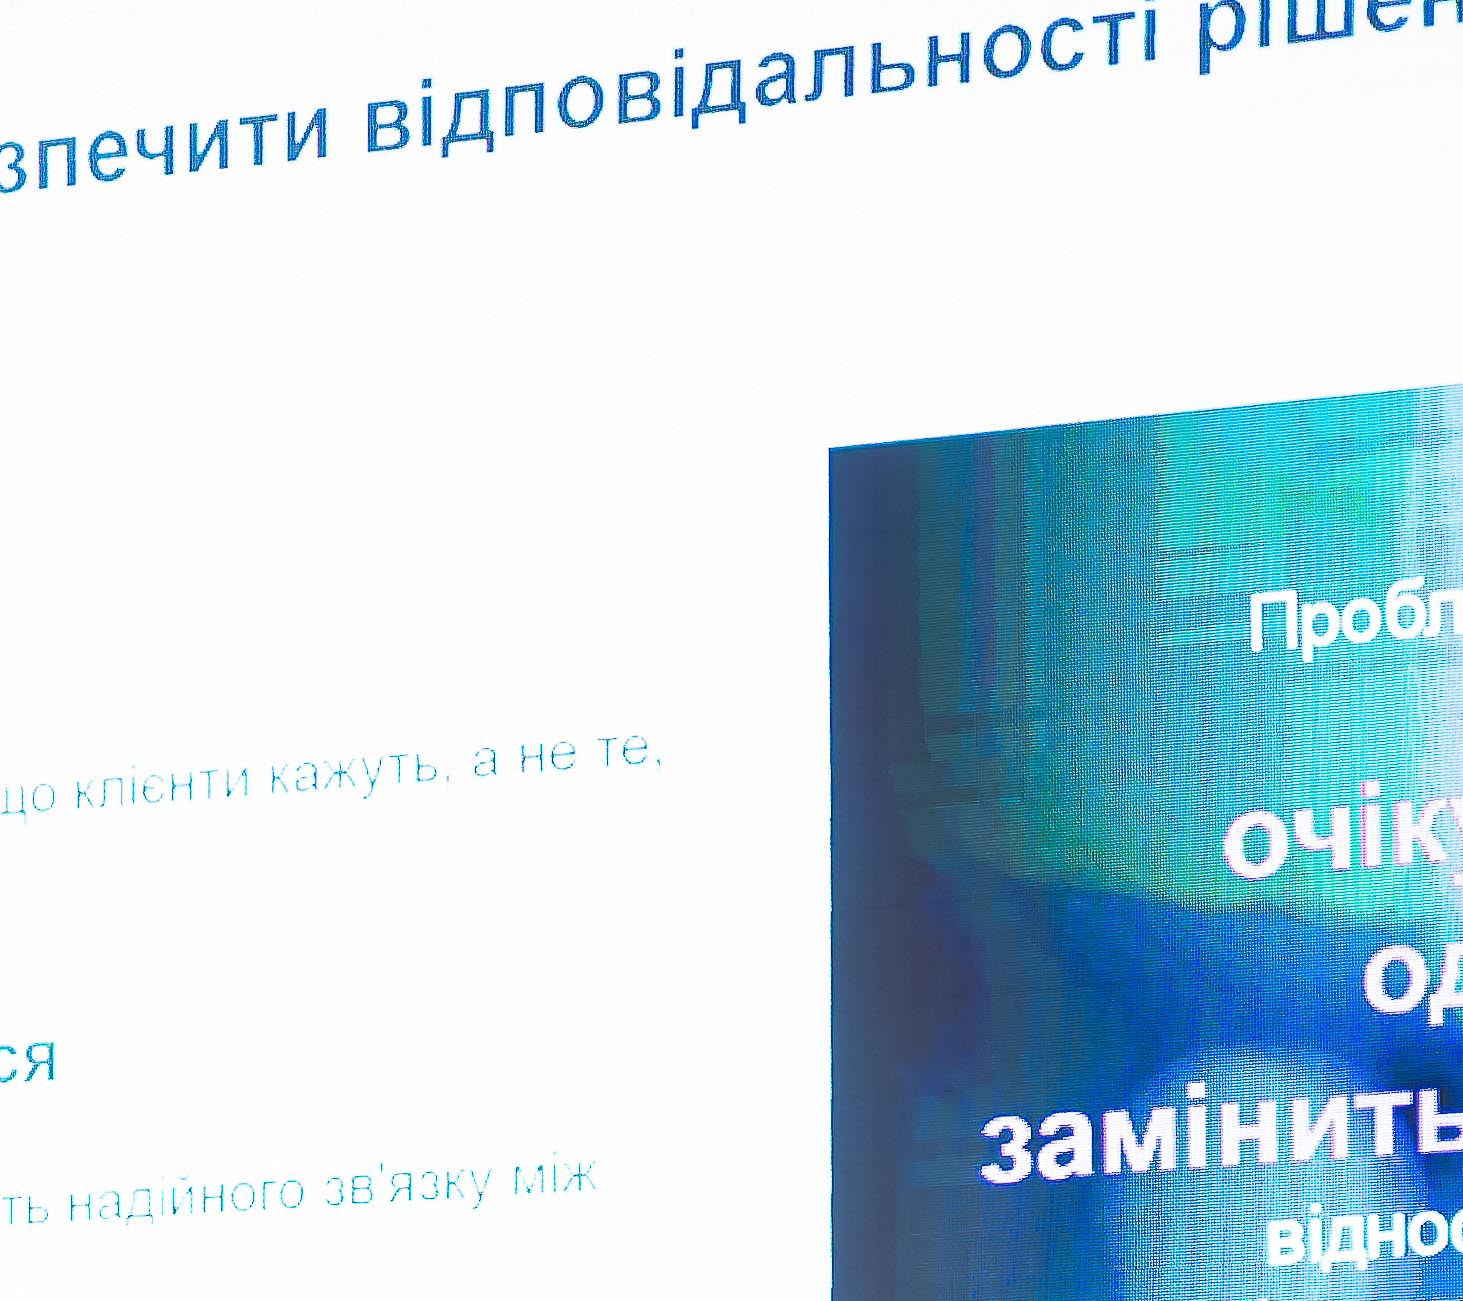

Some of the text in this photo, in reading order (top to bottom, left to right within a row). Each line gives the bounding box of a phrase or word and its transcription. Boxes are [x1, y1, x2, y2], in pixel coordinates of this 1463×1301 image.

[366, 0, 1157, 159] відповідальності
[74, 754, 250, 811] клієнти
[471, 741, 498, 779] а
[518, 735, 577, 775] не
[595, 729, 663, 769] те,
[67, 1172, 306, 1227] надійного
[512, 1150, 600, 1201] між
